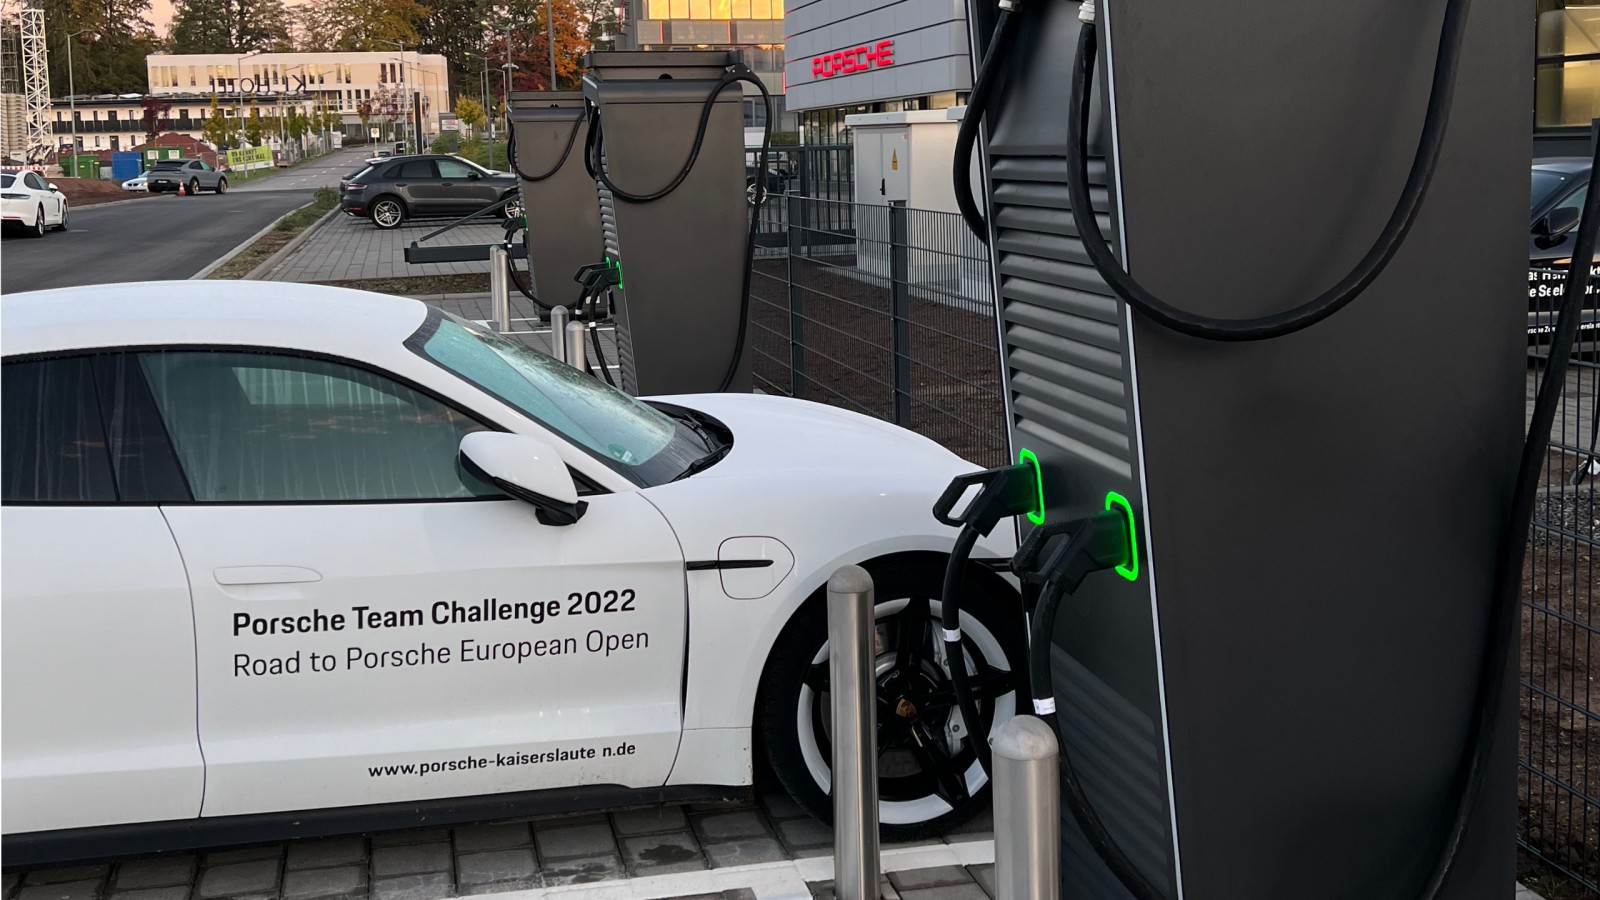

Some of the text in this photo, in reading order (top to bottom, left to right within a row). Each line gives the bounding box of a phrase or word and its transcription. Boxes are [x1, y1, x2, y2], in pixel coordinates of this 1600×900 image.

[811, 39, 894, 80] PORSCHE
[233, 588, 636, 636] Porsche Team Challenge 2022
[234, 629, 649, 677] Road to Porsche European Open
